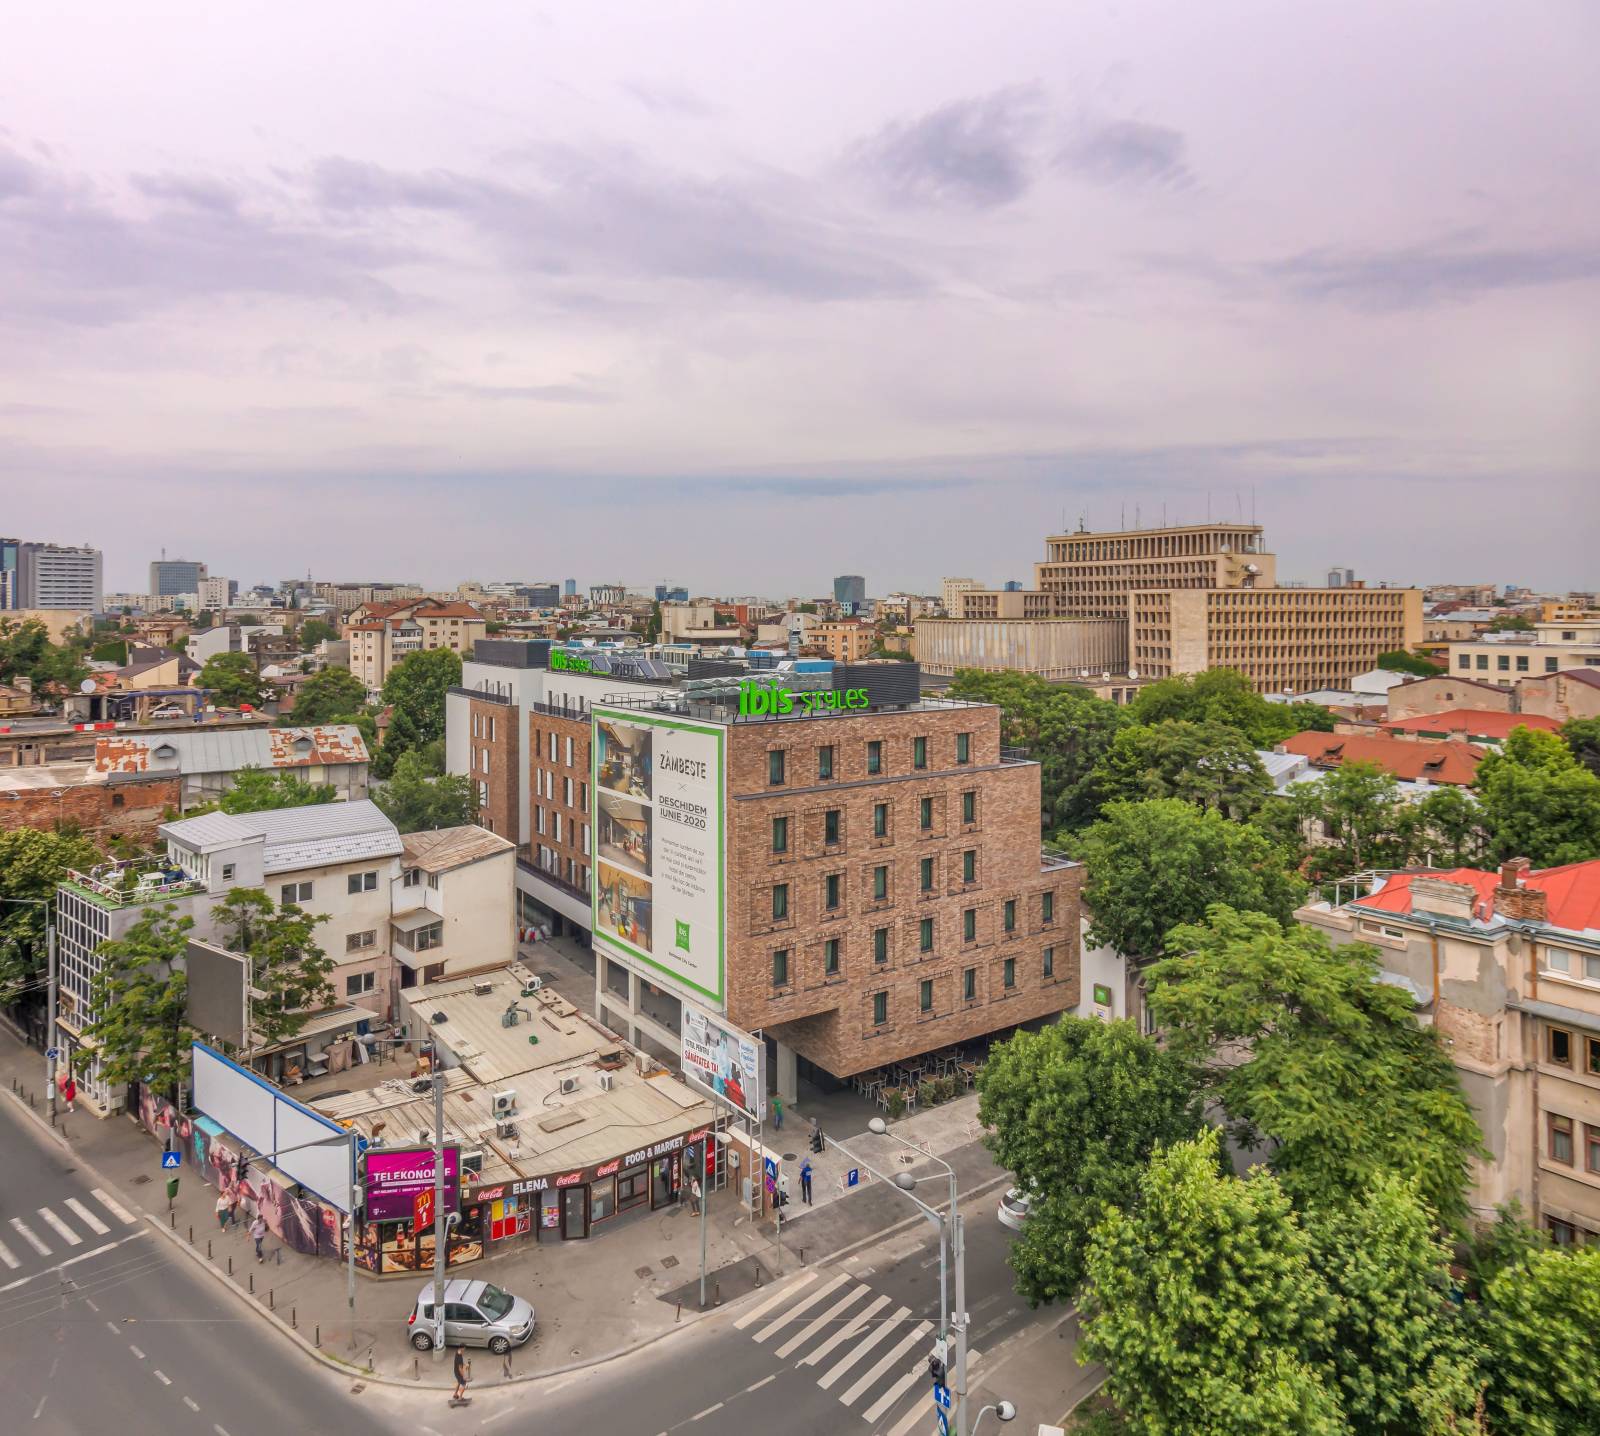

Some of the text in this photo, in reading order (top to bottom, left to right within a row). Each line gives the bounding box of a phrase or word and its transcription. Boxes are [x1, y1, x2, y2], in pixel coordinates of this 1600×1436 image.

[738, 679, 794, 716] ibis
[659, 795, 707, 816] DESCHIDEM
[660, 808, 706, 829] IUNIE 2020
[625, 1135, 684, 1166] FOOD & MARKET
[373, 1168, 451, 1181] TELEKONOE
[512, 1178, 549, 1195] ELENA
